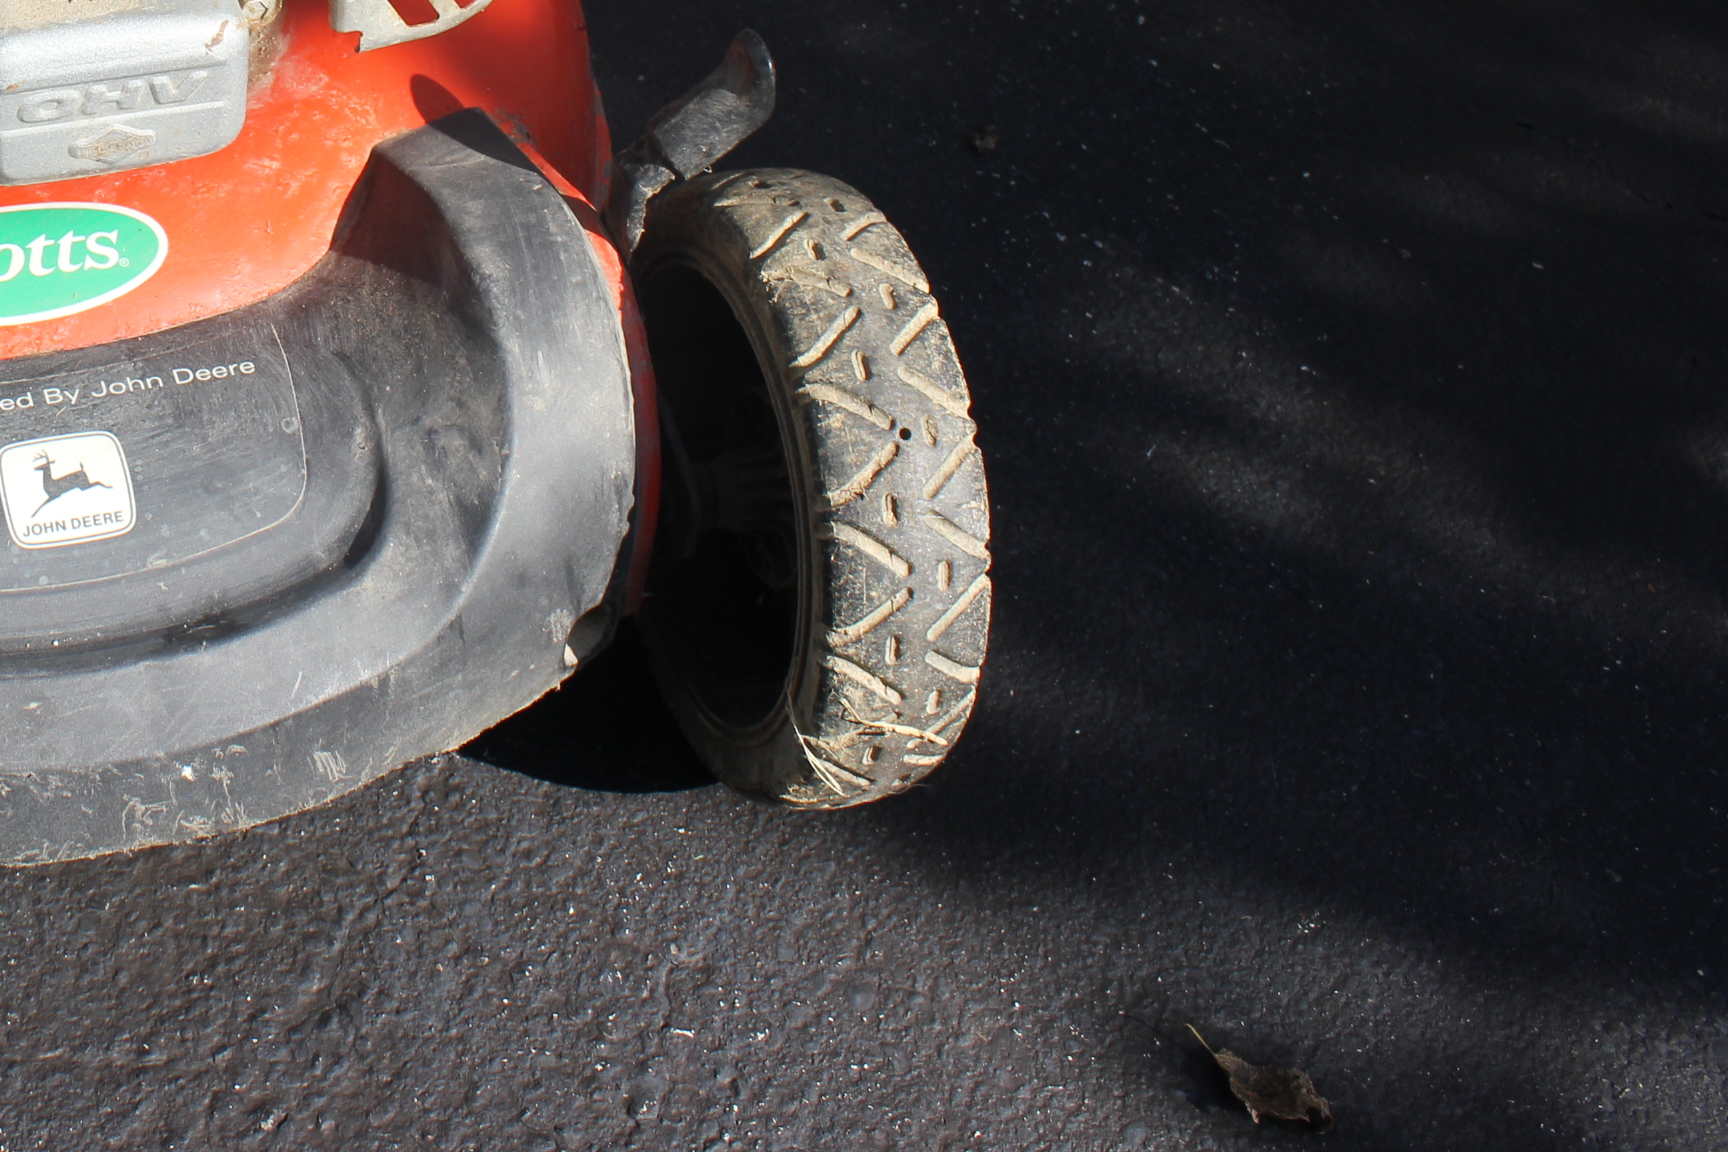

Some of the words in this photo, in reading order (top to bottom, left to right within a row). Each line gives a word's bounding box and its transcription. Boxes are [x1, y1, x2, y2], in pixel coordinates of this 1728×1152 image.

[17, 69, 210, 124] OHV
[43, 388, 79, 405] By
[91, 376, 164, 398] John
[172, 361, 256, 385] Deere
[23, 519, 67, 537] JOHN
[71, 510, 124, 530] DEERE
